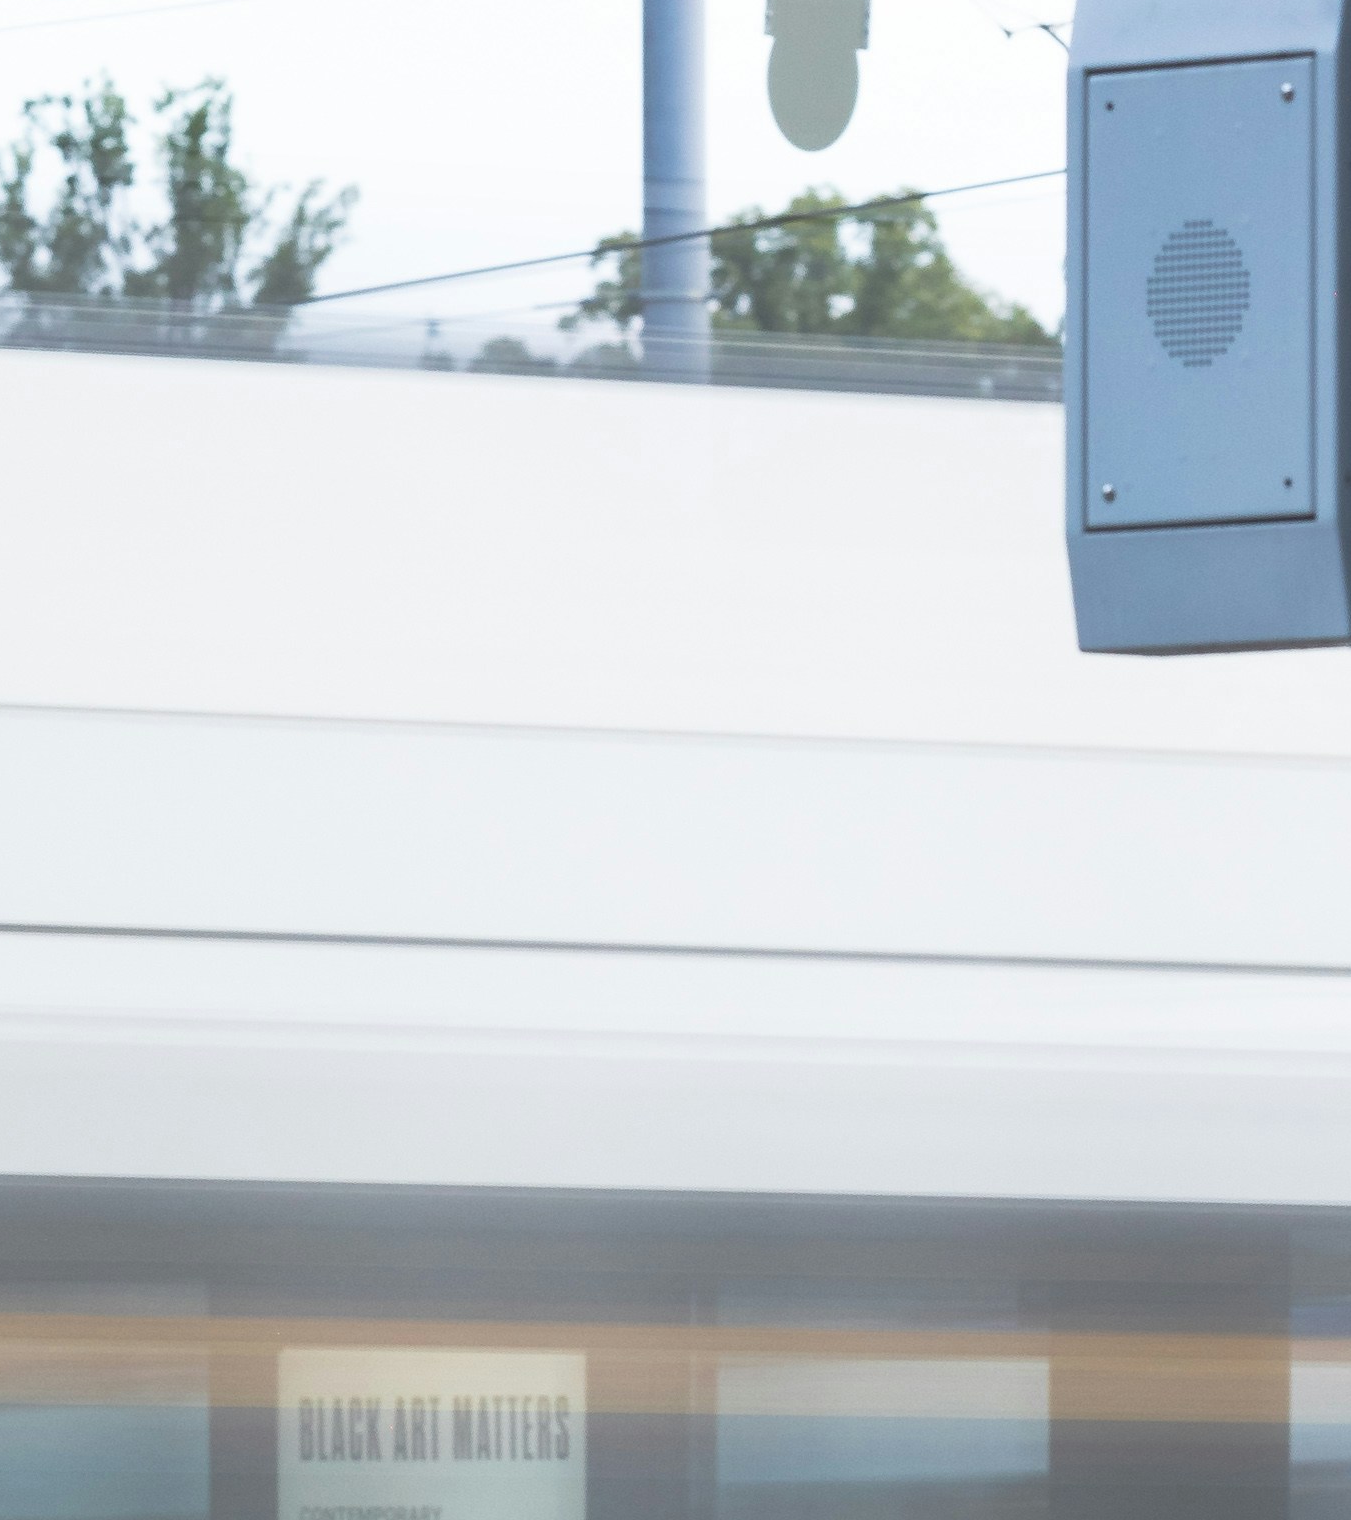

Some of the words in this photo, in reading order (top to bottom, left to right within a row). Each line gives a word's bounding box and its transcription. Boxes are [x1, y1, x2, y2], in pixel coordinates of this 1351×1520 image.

[298, 1395, 383, 1462] BLACK
[393, 1396, 441, 1462] ART
[452, 1395, 571, 1461] MATTERS
